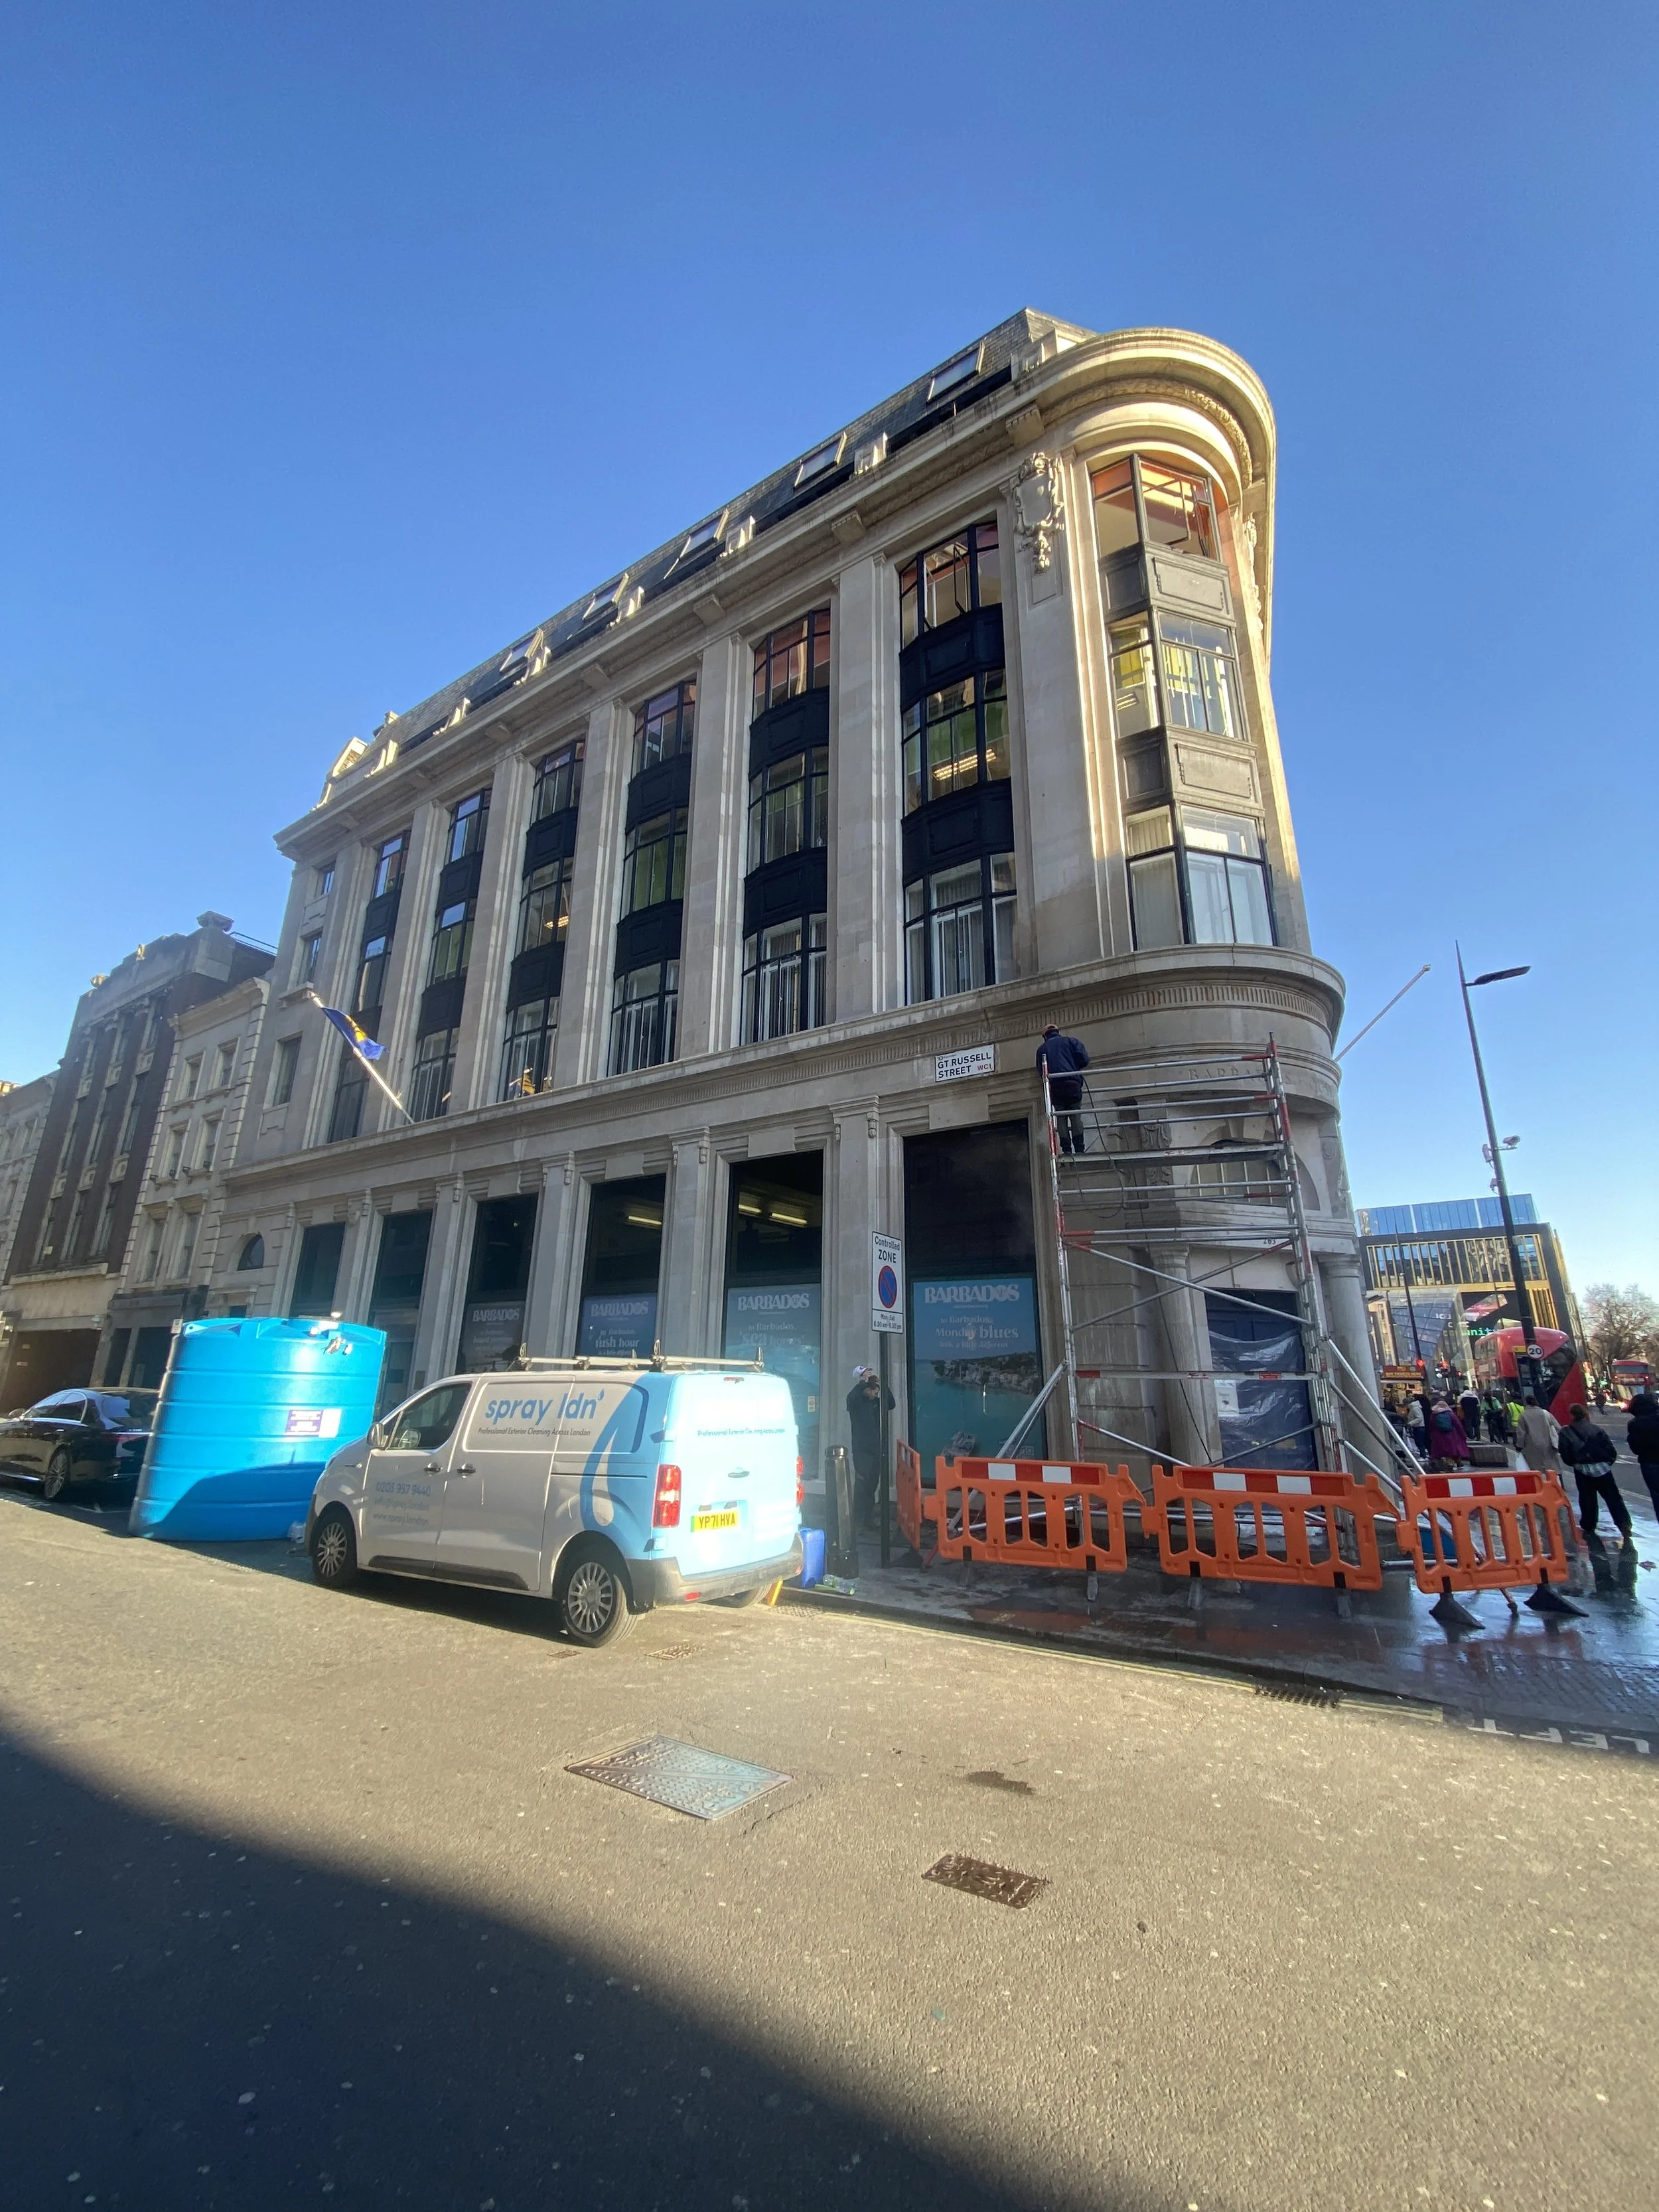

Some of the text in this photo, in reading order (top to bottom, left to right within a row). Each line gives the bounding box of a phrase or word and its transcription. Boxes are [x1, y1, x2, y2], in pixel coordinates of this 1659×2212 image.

[952, 1052, 991, 1066] RUSSELL
[938, 1065, 971, 1078] STREET
[875, 1236, 900, 1251] Controlled
[878, 1249, 897, 1263] ZONE
[924, 1284, 1020, 1303] BARBADOS
[591, 1301, 649, 1317] BARBADOS
[738, 1293, 810, 1311] BARBADOS
[472, 1307, 520, 1322] BARBADOS
[979, 1325, 1019, 1339] blues
[618, 1338, 640, 1347] hour
[484, 1399, 553, 1426] spray
[528, 1428, 551, 1437] Cleaning
[376, 1481, 395, 1493] 0203
[411, 1484, 431, 1497] 9440
[699, 1512, 736, 1528] YP71 HVA
